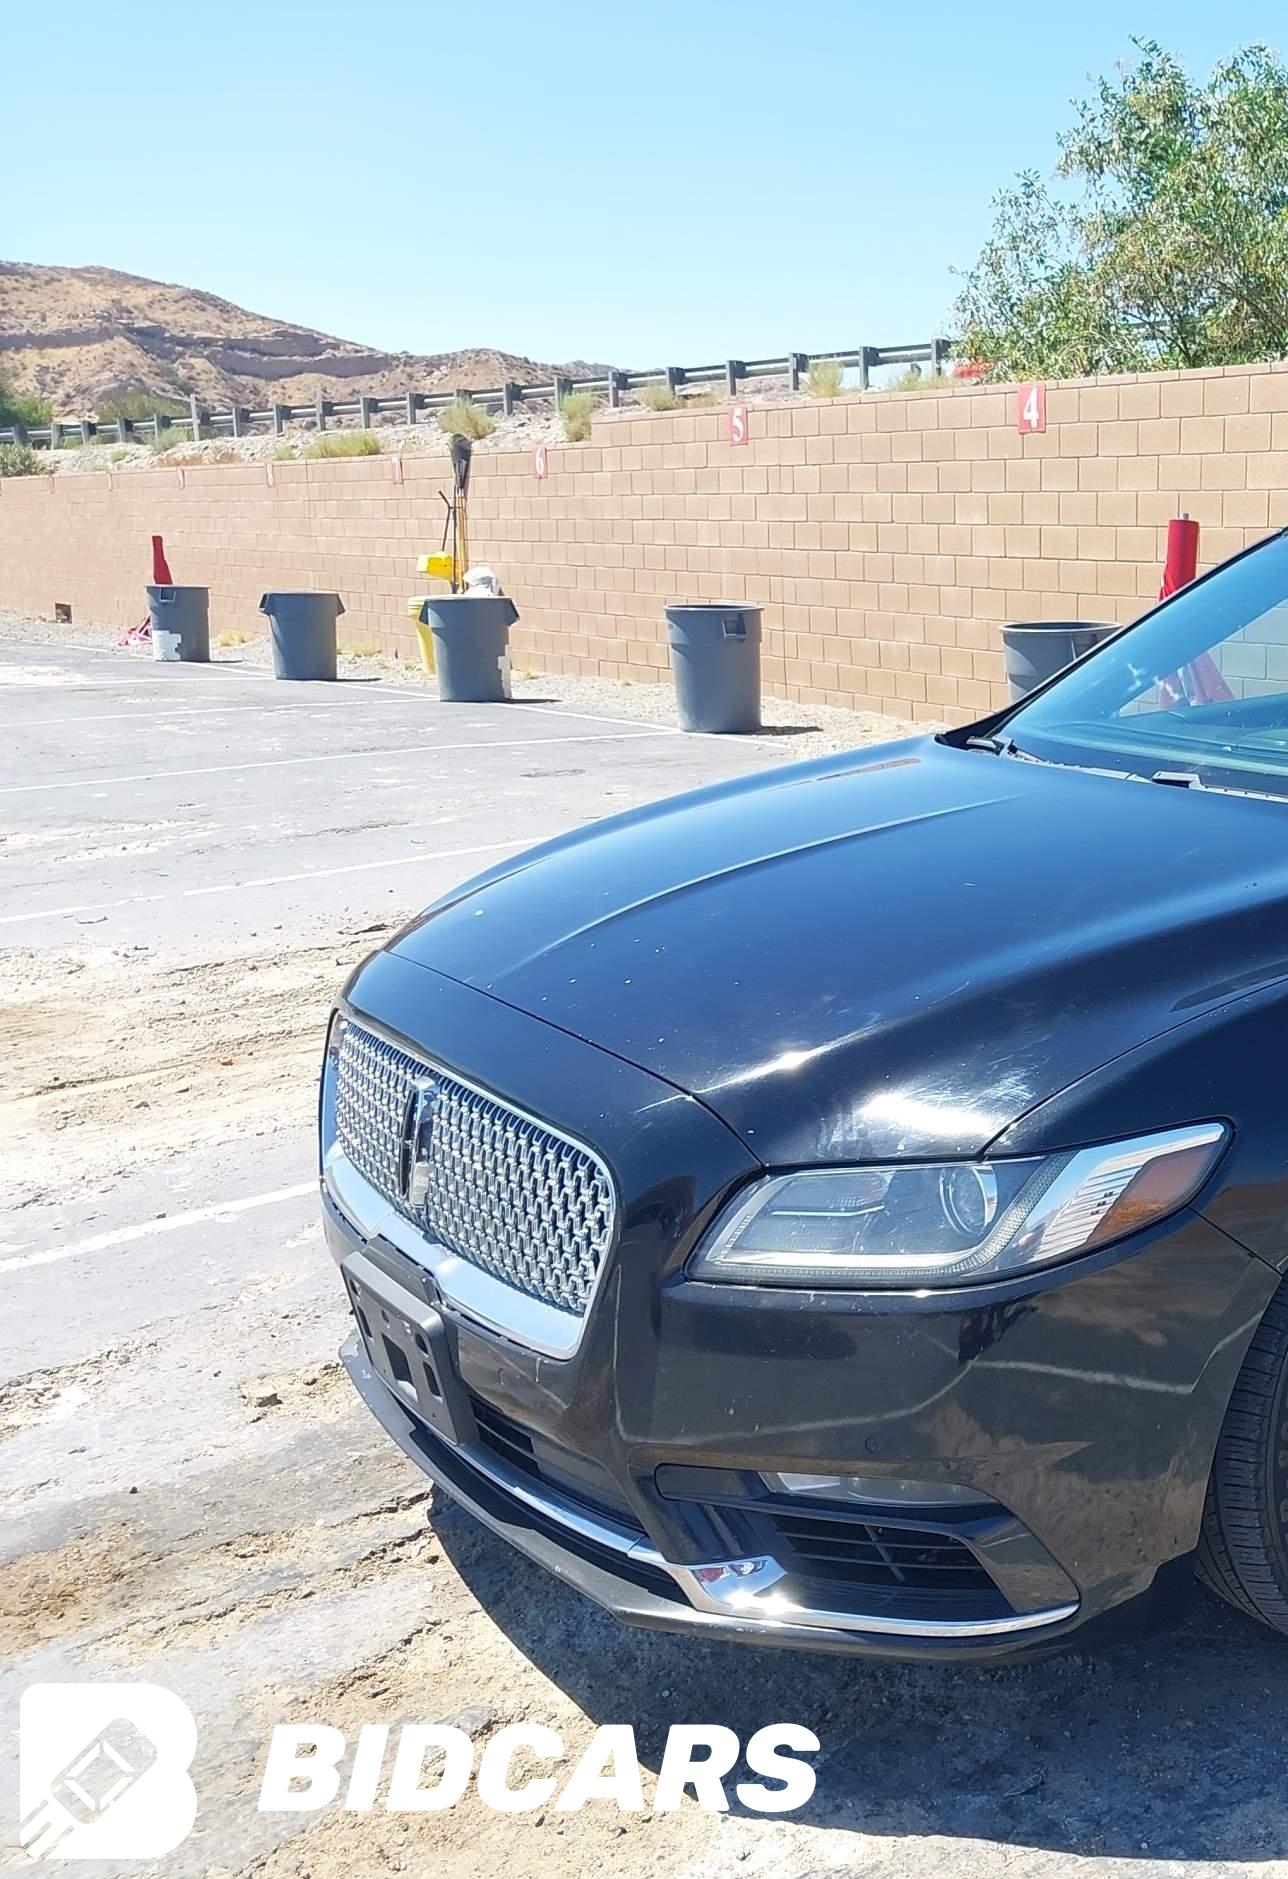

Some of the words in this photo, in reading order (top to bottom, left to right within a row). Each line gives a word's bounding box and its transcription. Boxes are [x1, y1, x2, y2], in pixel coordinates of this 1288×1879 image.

[732, 407, 744, 442] 5
[1023, 386, 1040, 429] 4
[535, 448, 544, 475] 6
